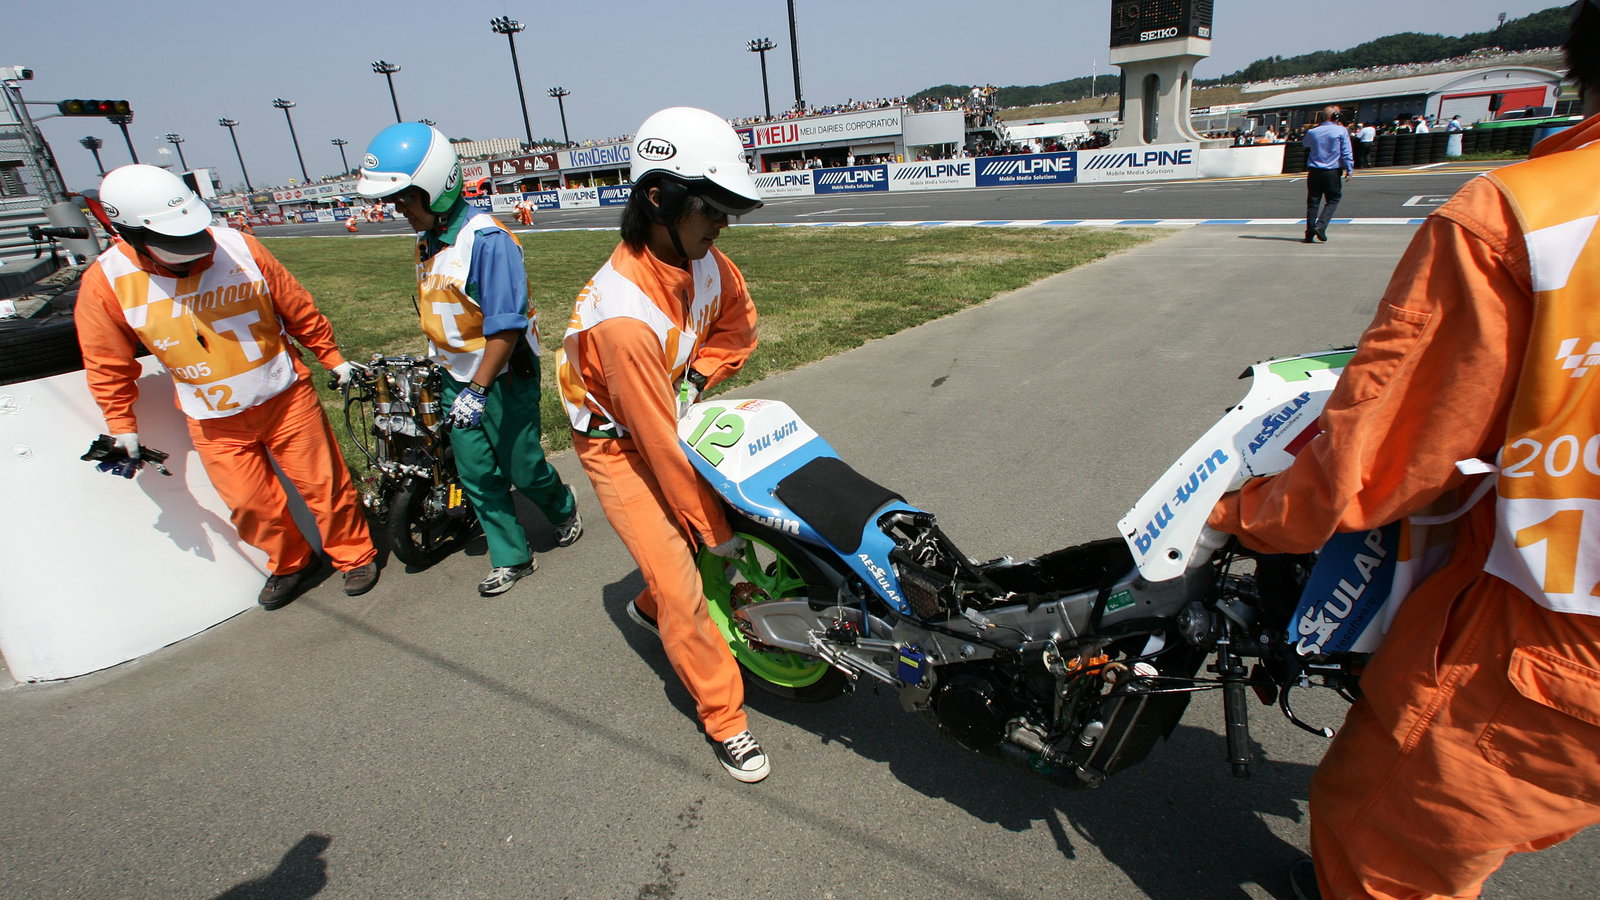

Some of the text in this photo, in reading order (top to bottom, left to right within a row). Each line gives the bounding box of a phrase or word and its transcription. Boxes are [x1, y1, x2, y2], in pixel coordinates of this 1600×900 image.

[1140, 27, 1178, 41] SEIKO
[757, 118, 898, 145] MEIJI MEIJI DAIRIES CORPORATION
[570, 145, 631, 167] KANDENKO
[640, 140, 671, 155] Arai
[981, 157, 1072, 175] ALPINE
[1083, 149, 1192, 170] ALPINE
[463, 166, 483, 178] SANYO
[755, 174, 811, 188] ALPINE
[818, 169, 884, 185] ALPINE
[893, 163, 970, 180] ALPINE
[431, 302, 465, 347] T
[211, 309, 263, 362] T
[170, 361, 212, 379] 005
[194, 384, 241, 412] 12
[687, 406, 745, 467] 12
[1514, 509, 1600, 597] 1
